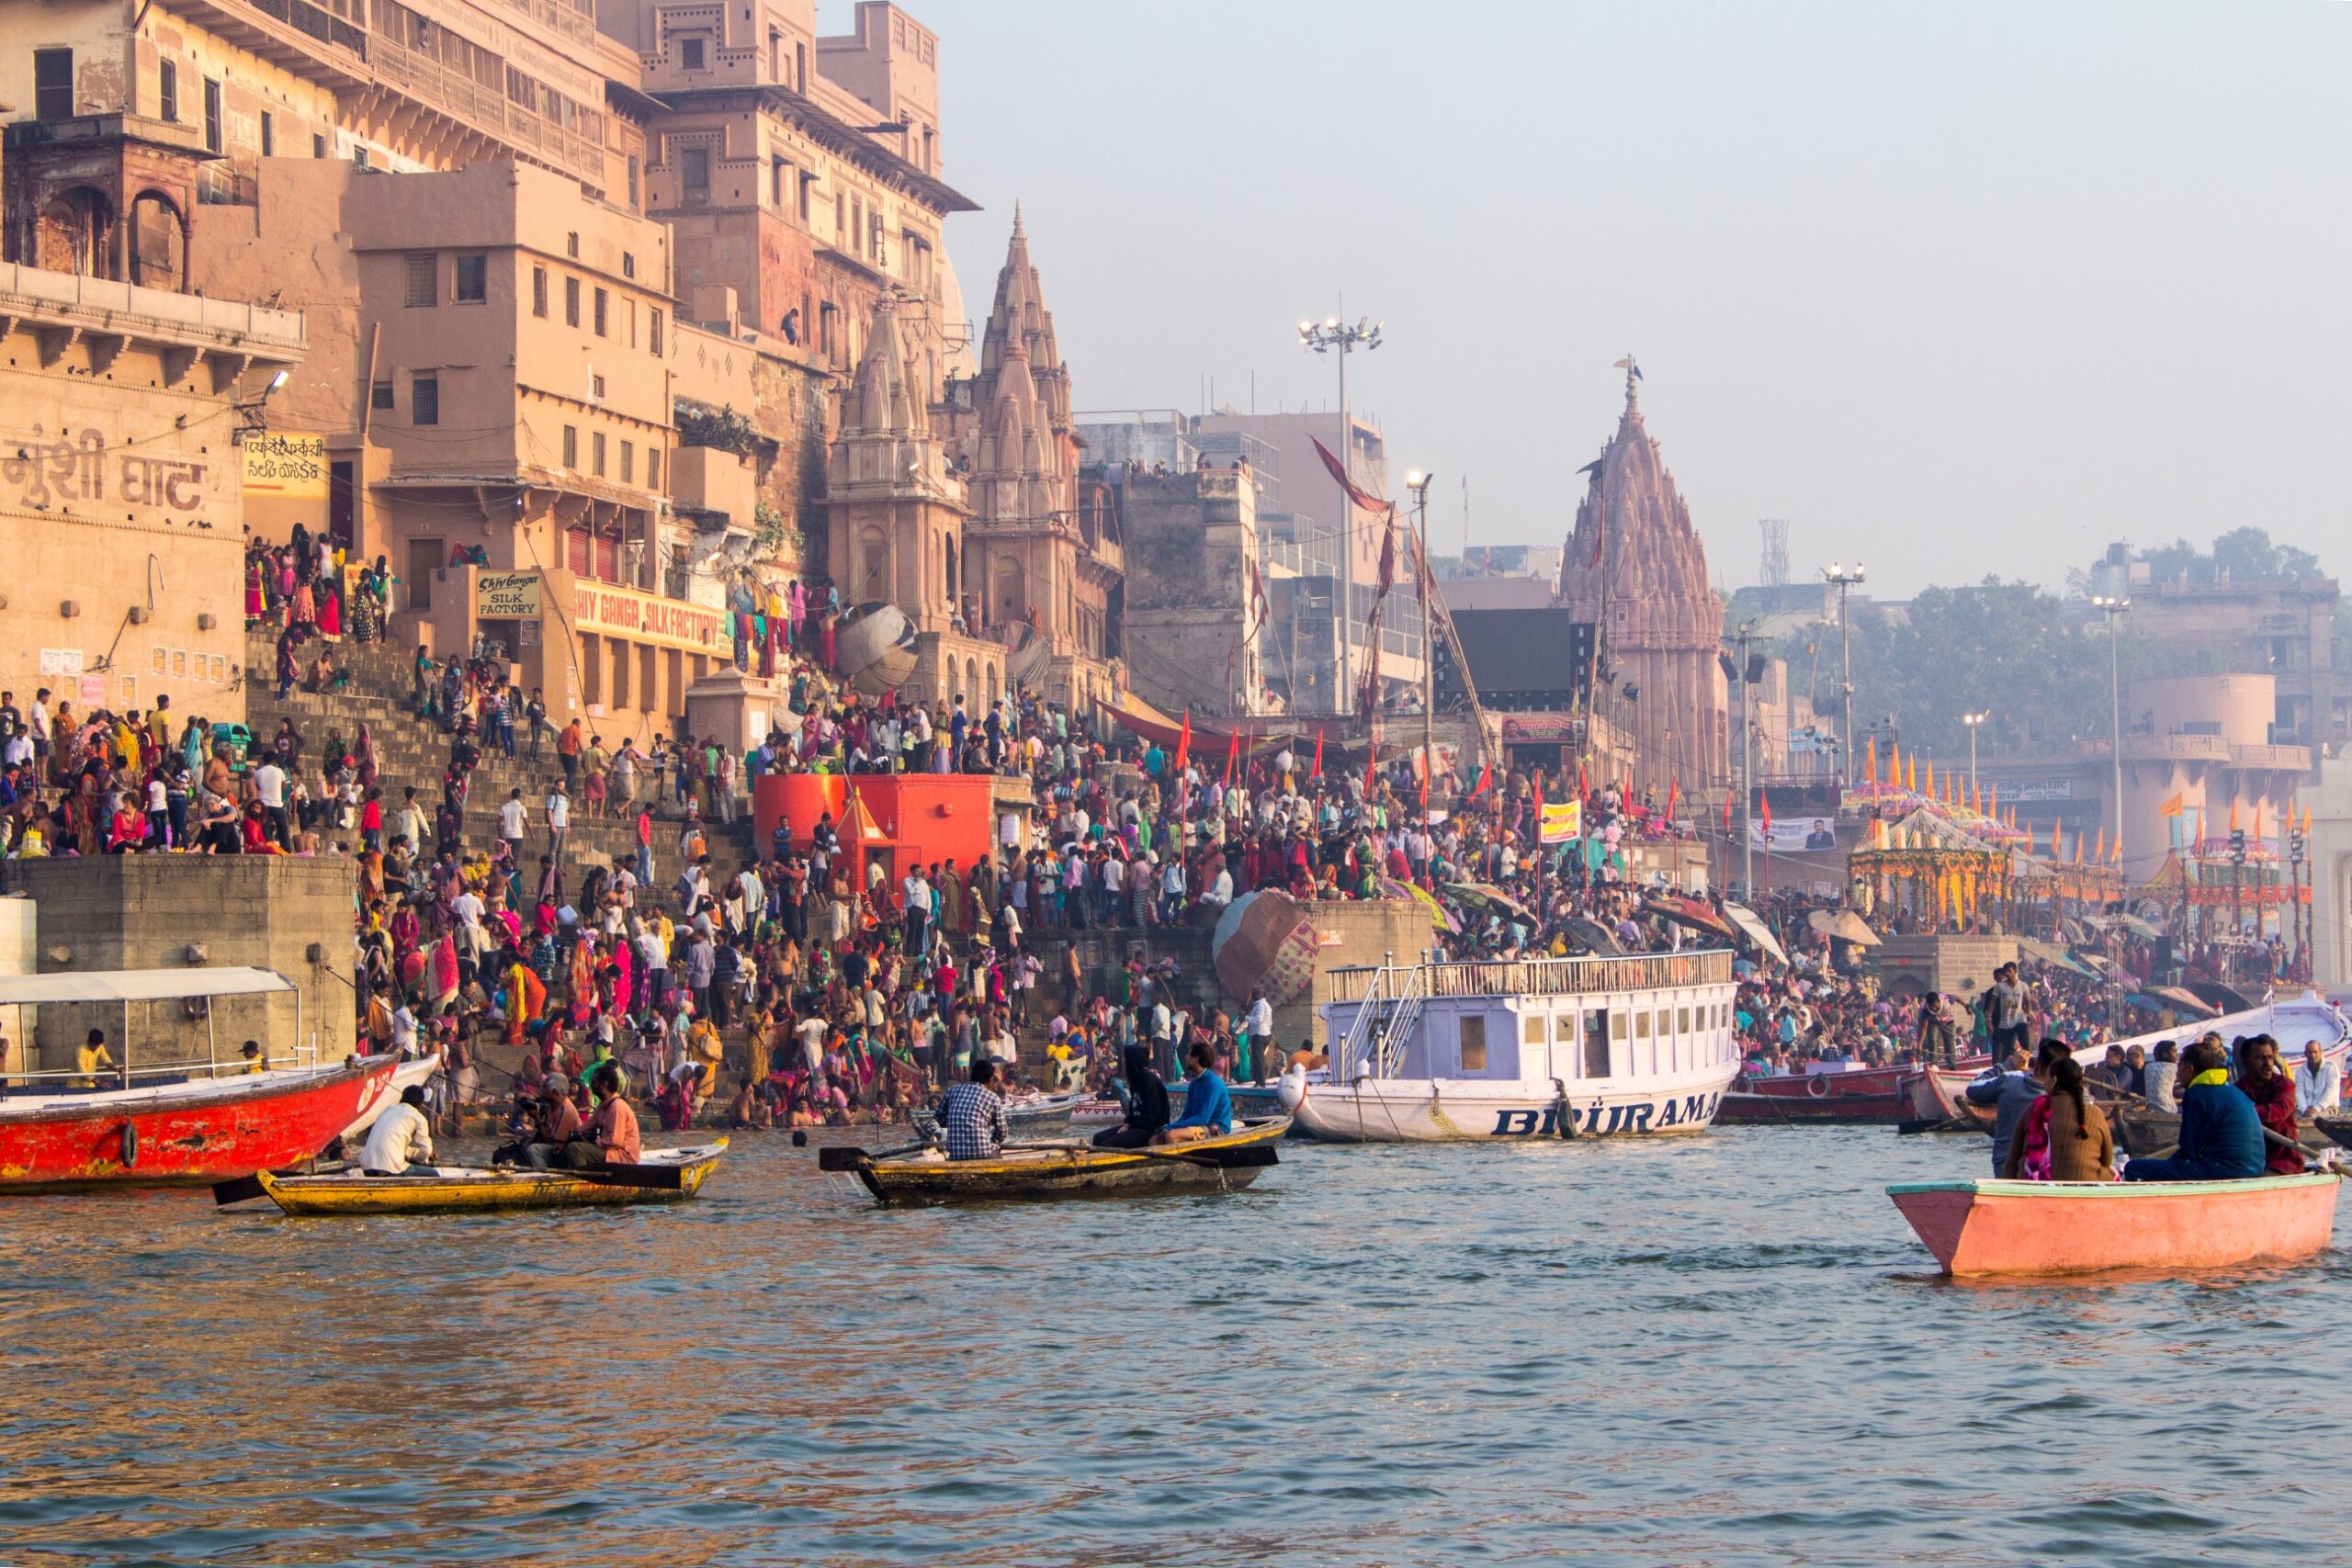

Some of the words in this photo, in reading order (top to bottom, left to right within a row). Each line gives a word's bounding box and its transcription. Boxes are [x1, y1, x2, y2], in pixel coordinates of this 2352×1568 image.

[119, 454, 208, 511] घाट
[479, 577, 506, 592] Shiv
[506, 574, 538, 587] Ganga
[491, 593, 524, 604] SILK
[480, 604, 535, 615] FACTORY
[601, 593, 639, 628] GANGA
[646, 602, 669, 635] SILK
[671, 607, 717, 646] FACTORY
